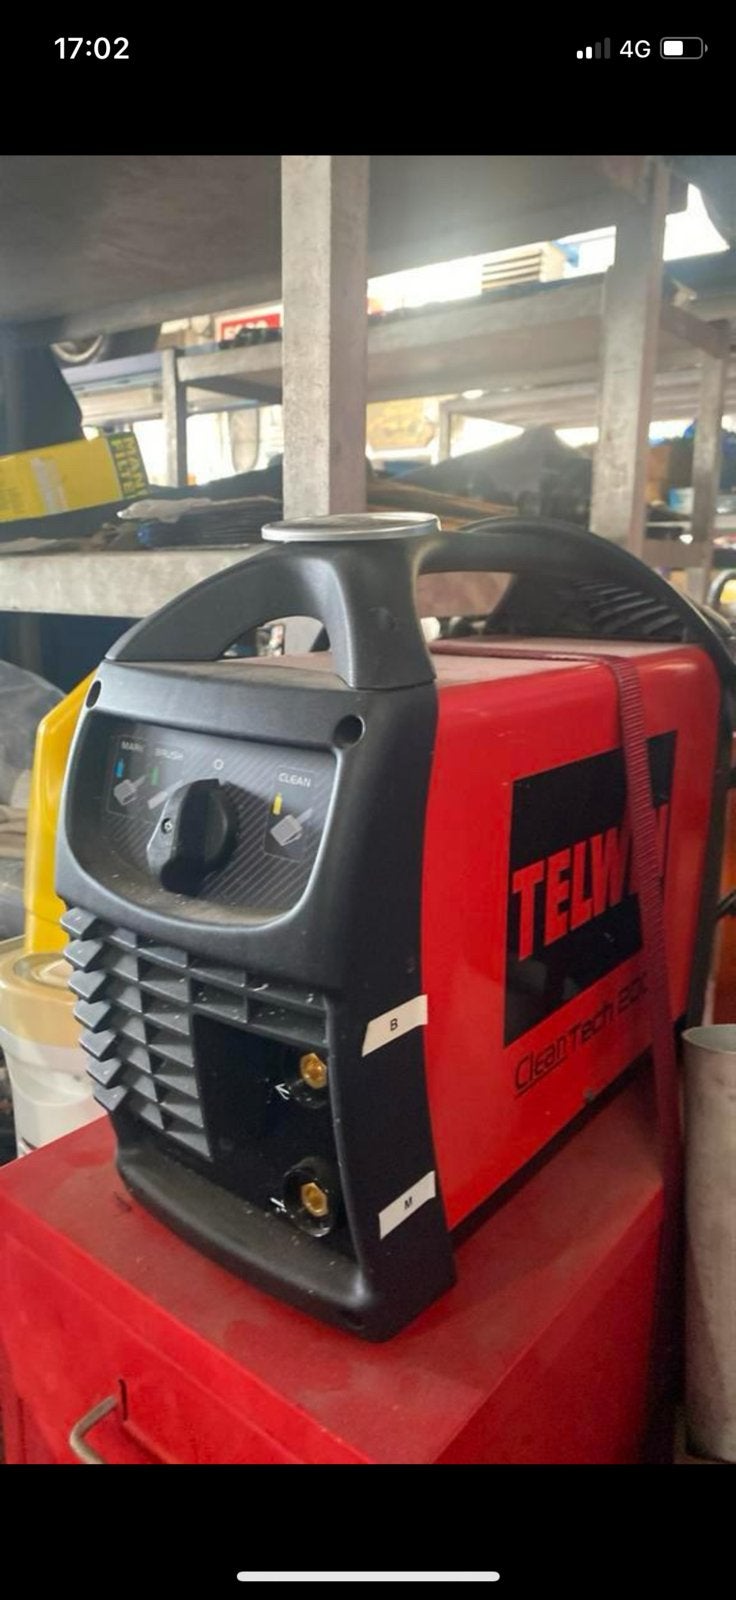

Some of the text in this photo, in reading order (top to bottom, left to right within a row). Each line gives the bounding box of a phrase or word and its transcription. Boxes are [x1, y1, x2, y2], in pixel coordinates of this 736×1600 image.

[278, 772, 312, 788] CLEAN
[389, 1017, 399, 1032] B
[403, 1195, 413, 1211] M
